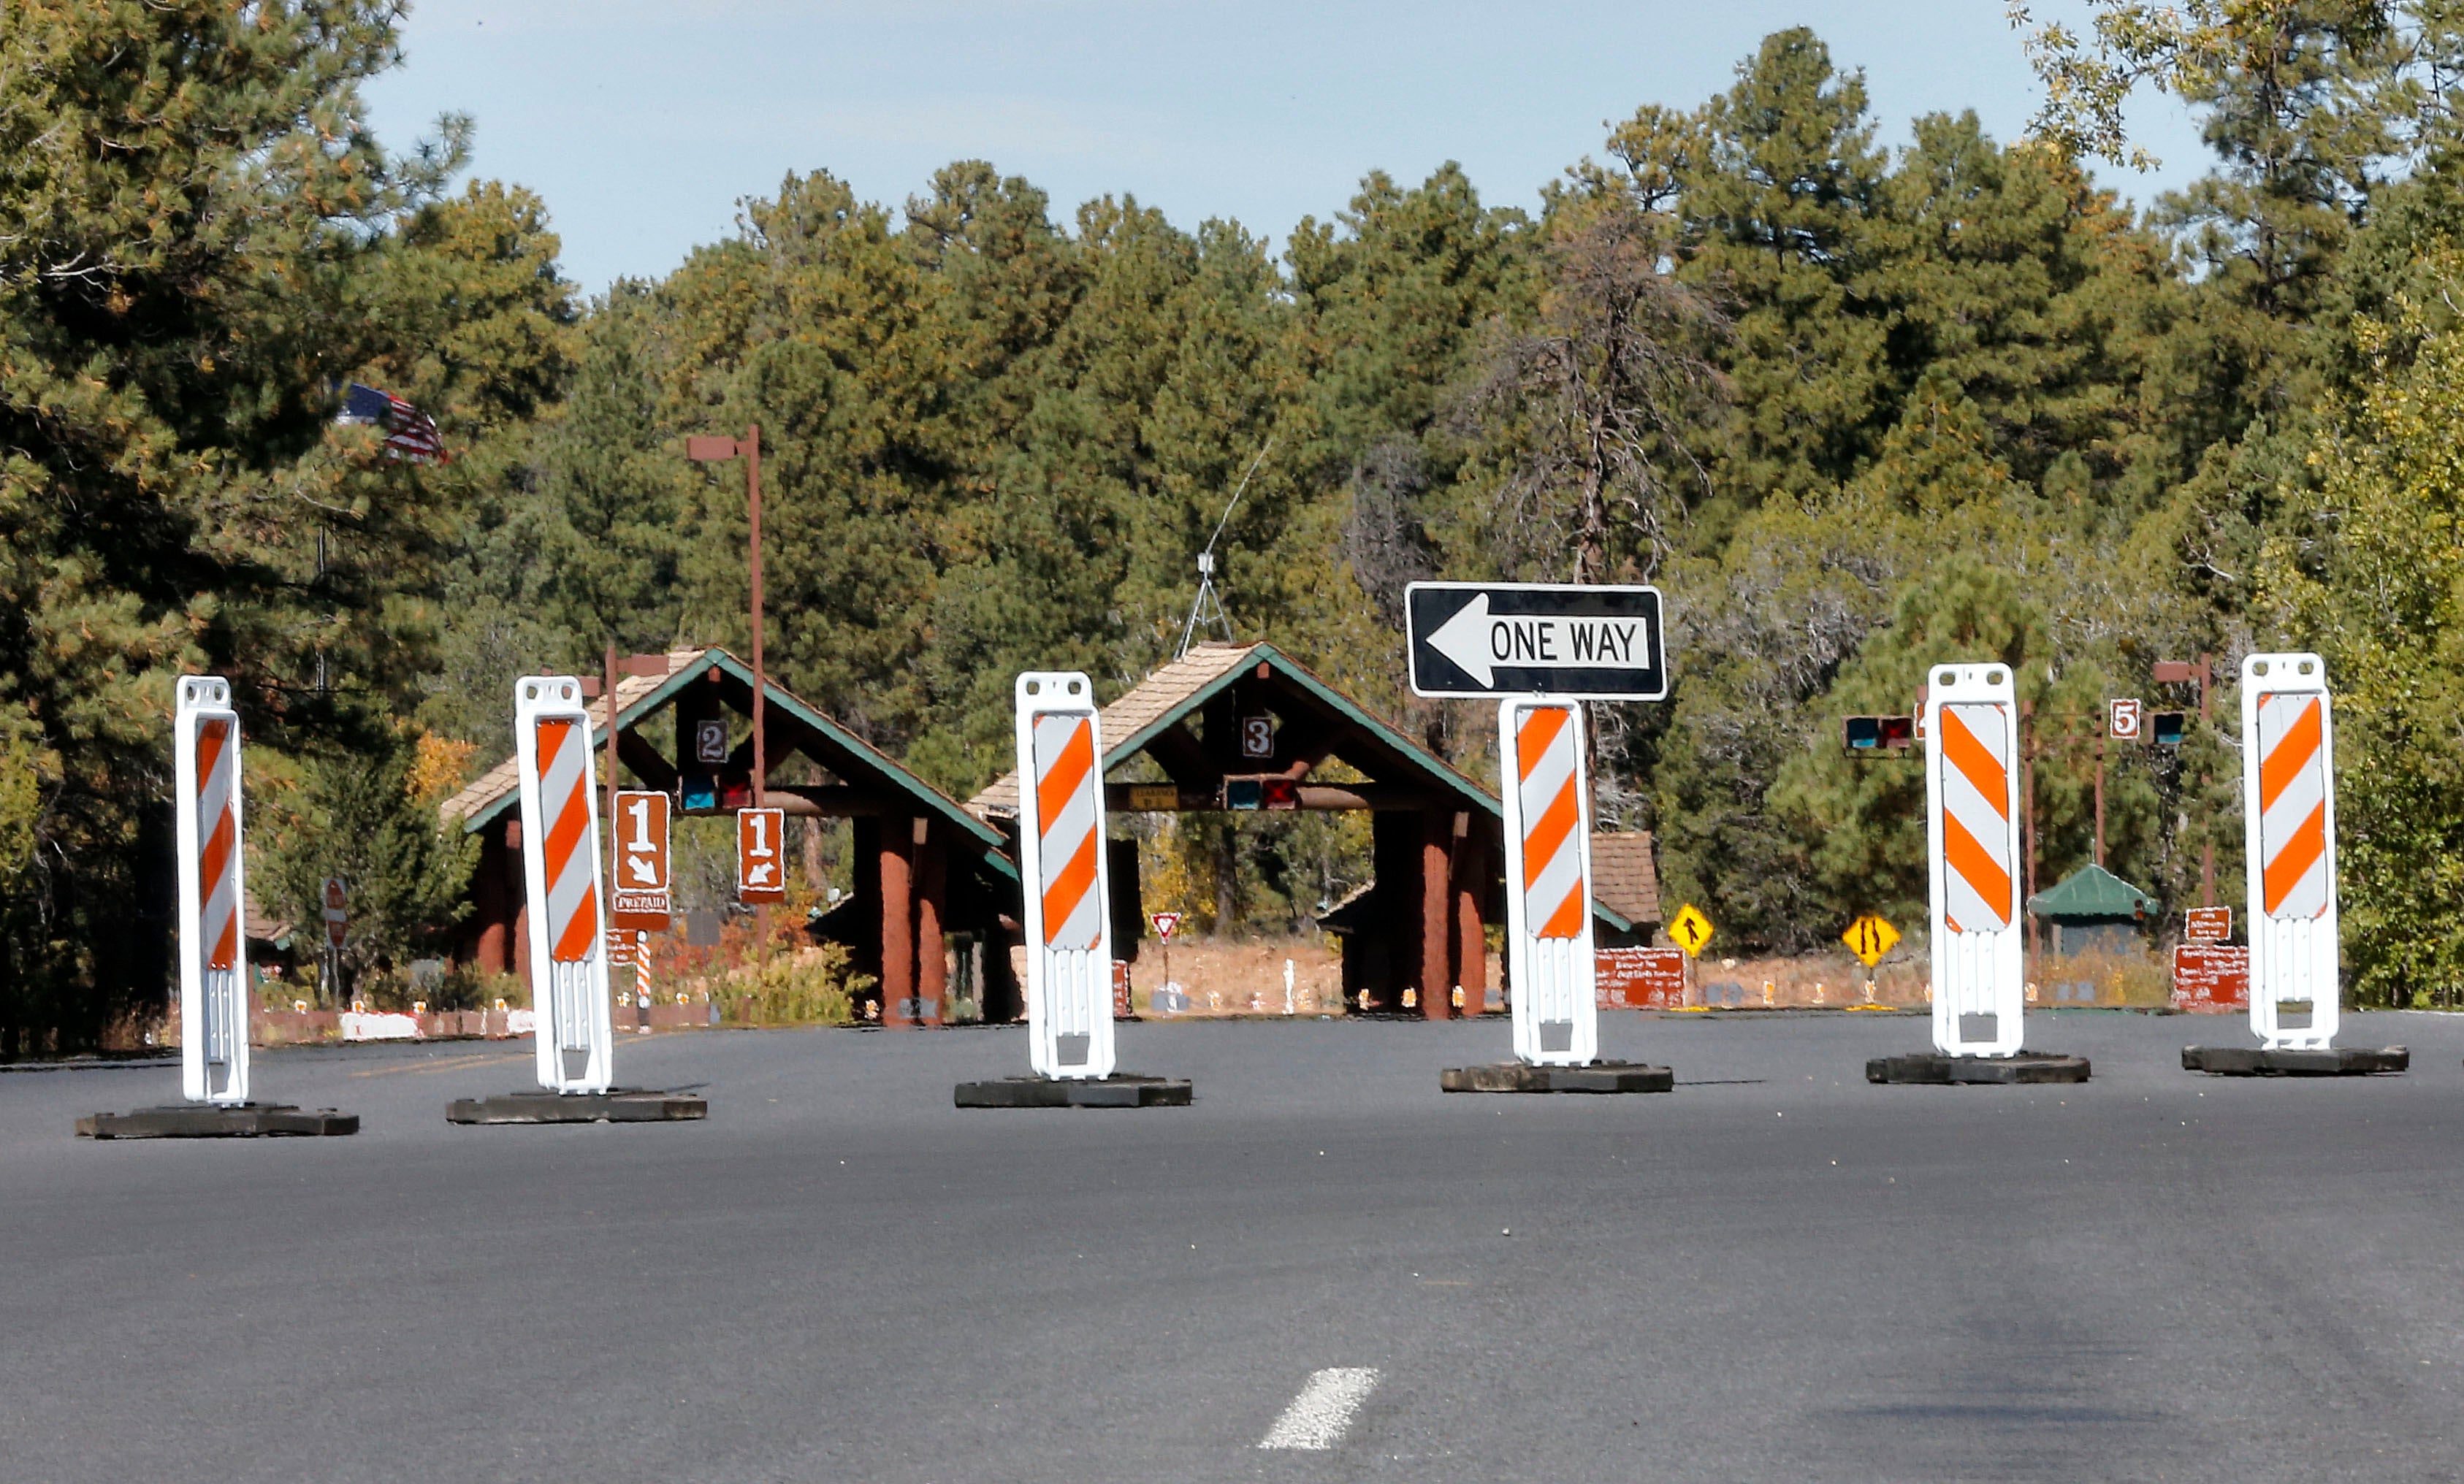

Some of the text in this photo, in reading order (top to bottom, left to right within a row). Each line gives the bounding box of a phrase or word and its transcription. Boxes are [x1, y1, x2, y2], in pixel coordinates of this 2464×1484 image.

[1491, 621, 1636, 662] ONE WAY
[1247, 720, 1271, 754] 3
[2114, 705, 2136, 735] 5
[703, 727, 723, 757] 2
[628, 799, 657, 852] 1
[749, 814, 774, 857] 1
[617, 895, 665, 909] PREPAID
